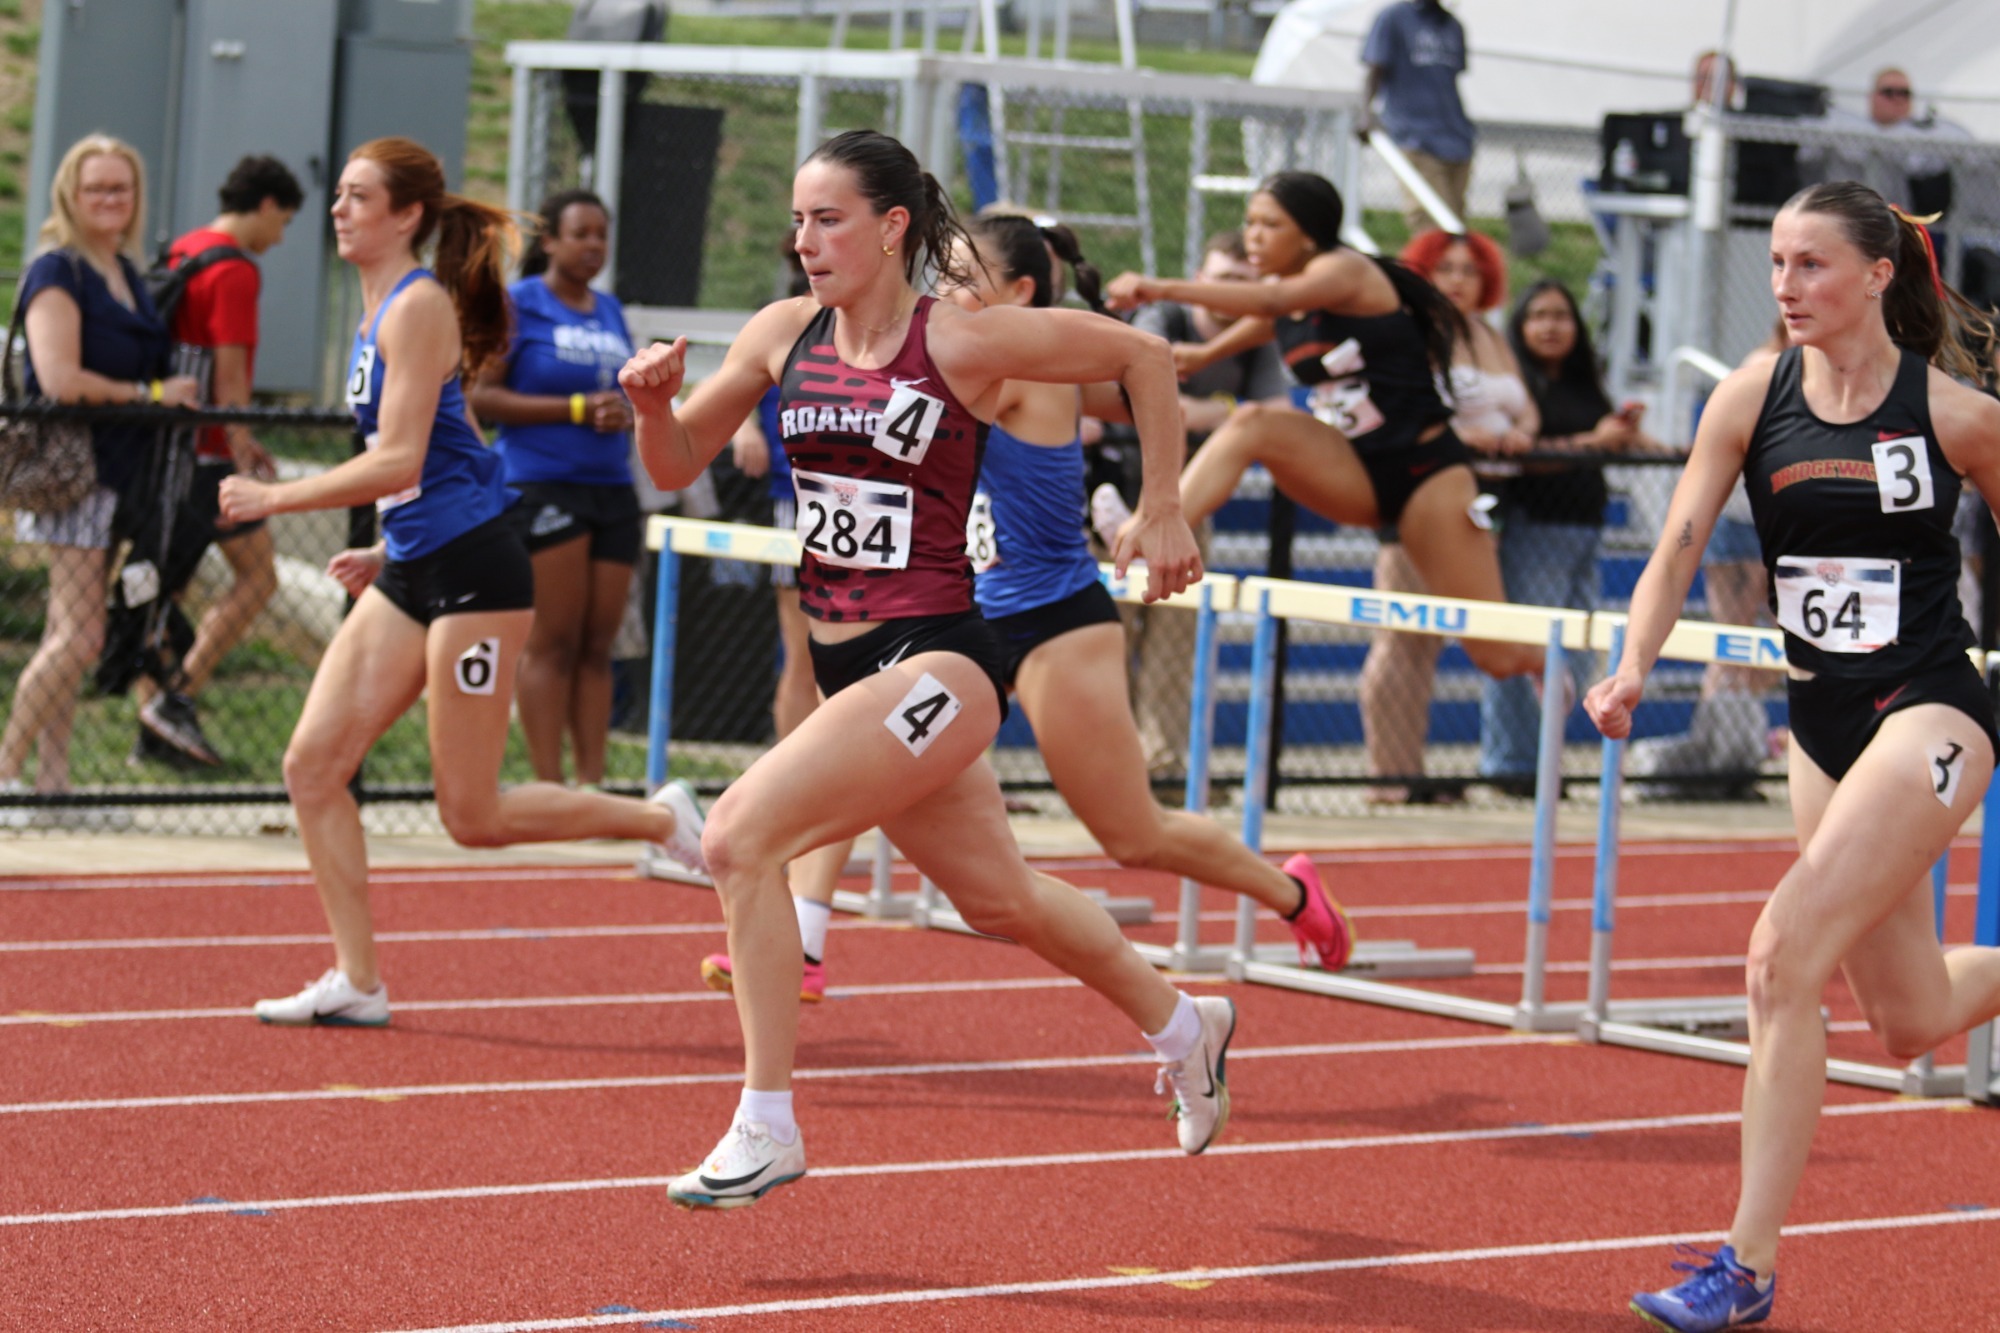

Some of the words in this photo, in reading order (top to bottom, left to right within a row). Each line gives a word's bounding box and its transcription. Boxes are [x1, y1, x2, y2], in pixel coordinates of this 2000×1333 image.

[885, 397, 930, 457] 4
[1769, 458, 1878, 495] BRIDGEWA
[1886, 444, 1921, 508] 3
[804, 500, 897, 564] 284
[1351, 597, 1468, 631] EMU
[1801, 589, 1867, 640] 64
[901, 691, 951, 745] 4
[1934, 741, 1964, 794] 3
